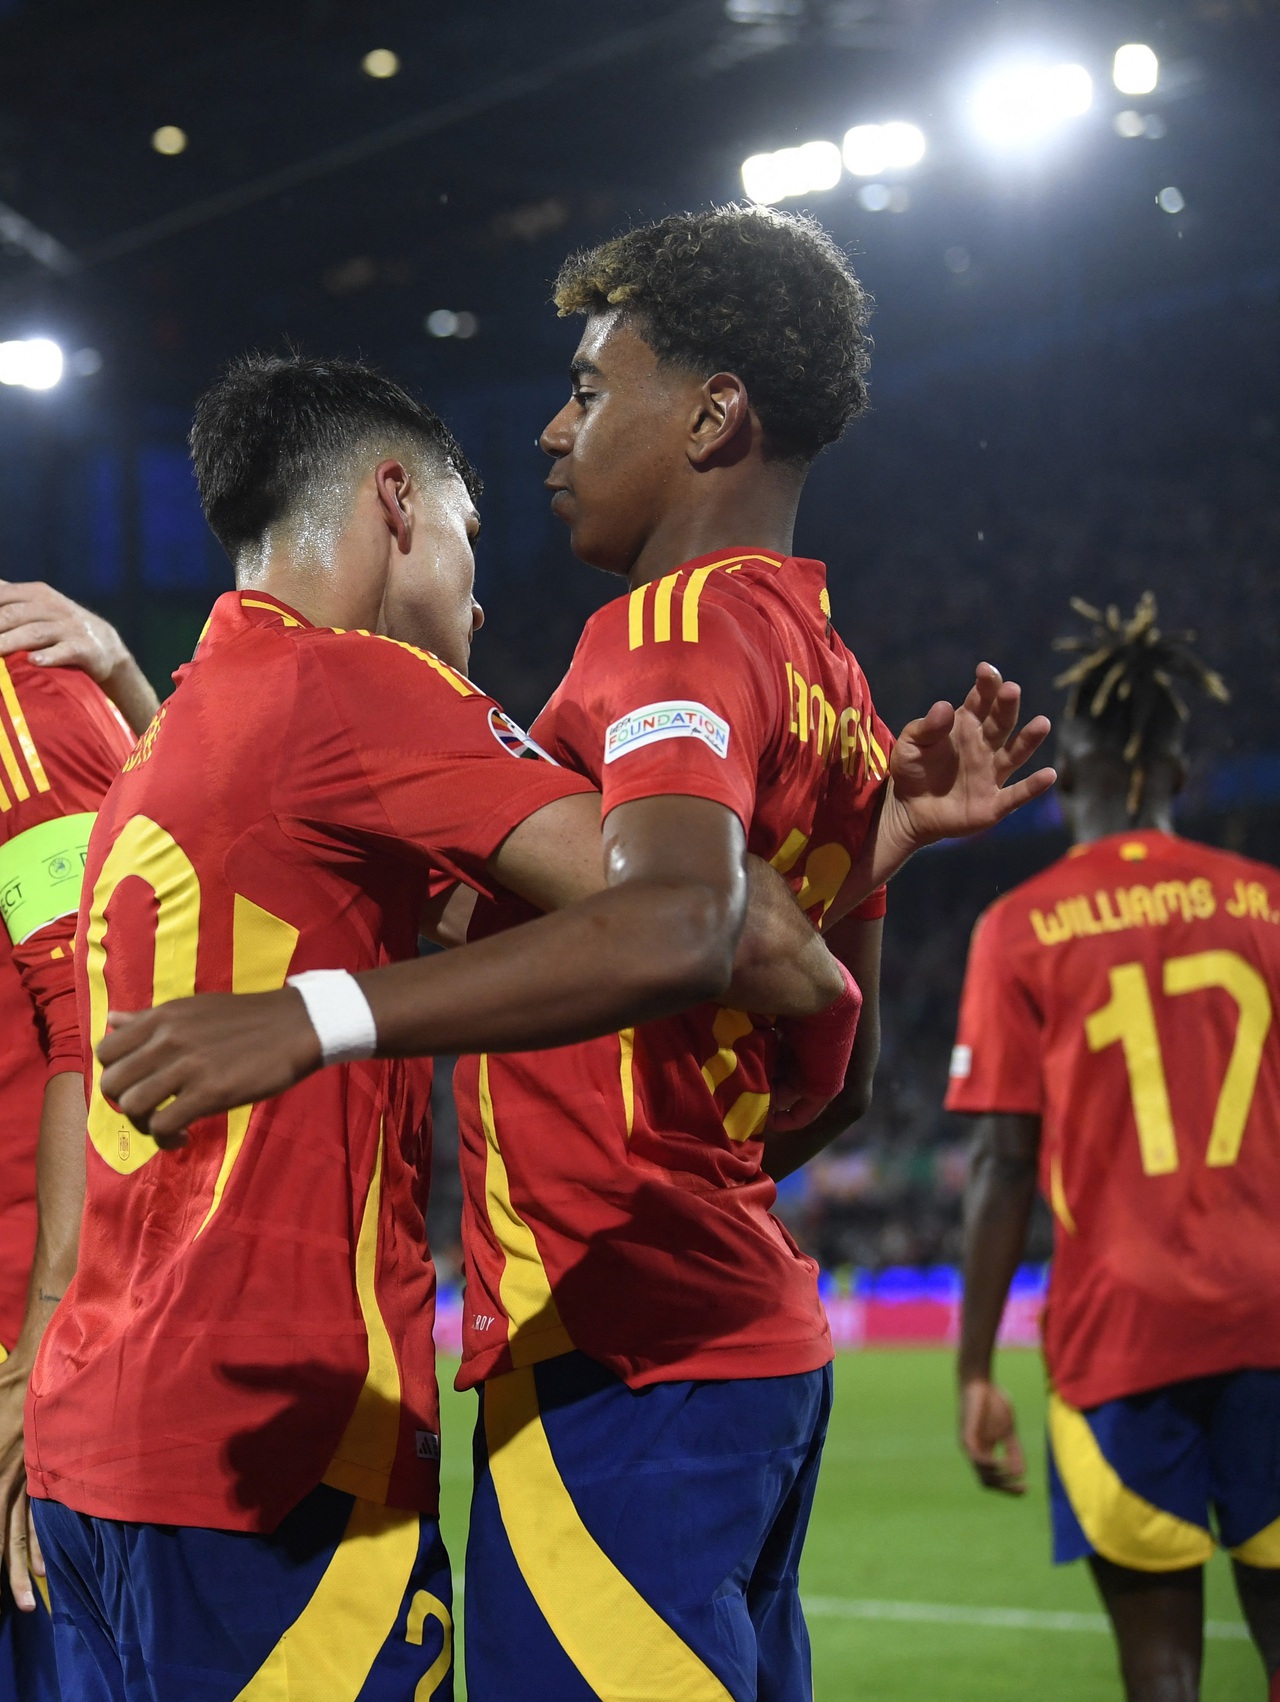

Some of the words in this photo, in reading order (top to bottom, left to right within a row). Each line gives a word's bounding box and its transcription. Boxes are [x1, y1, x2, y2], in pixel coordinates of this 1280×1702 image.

[608, 711, 726, 750] FOUNDATION
[1029, 877, 1217, 945] WILLIAMS
[1084, 950, 1271, 1176] 17
